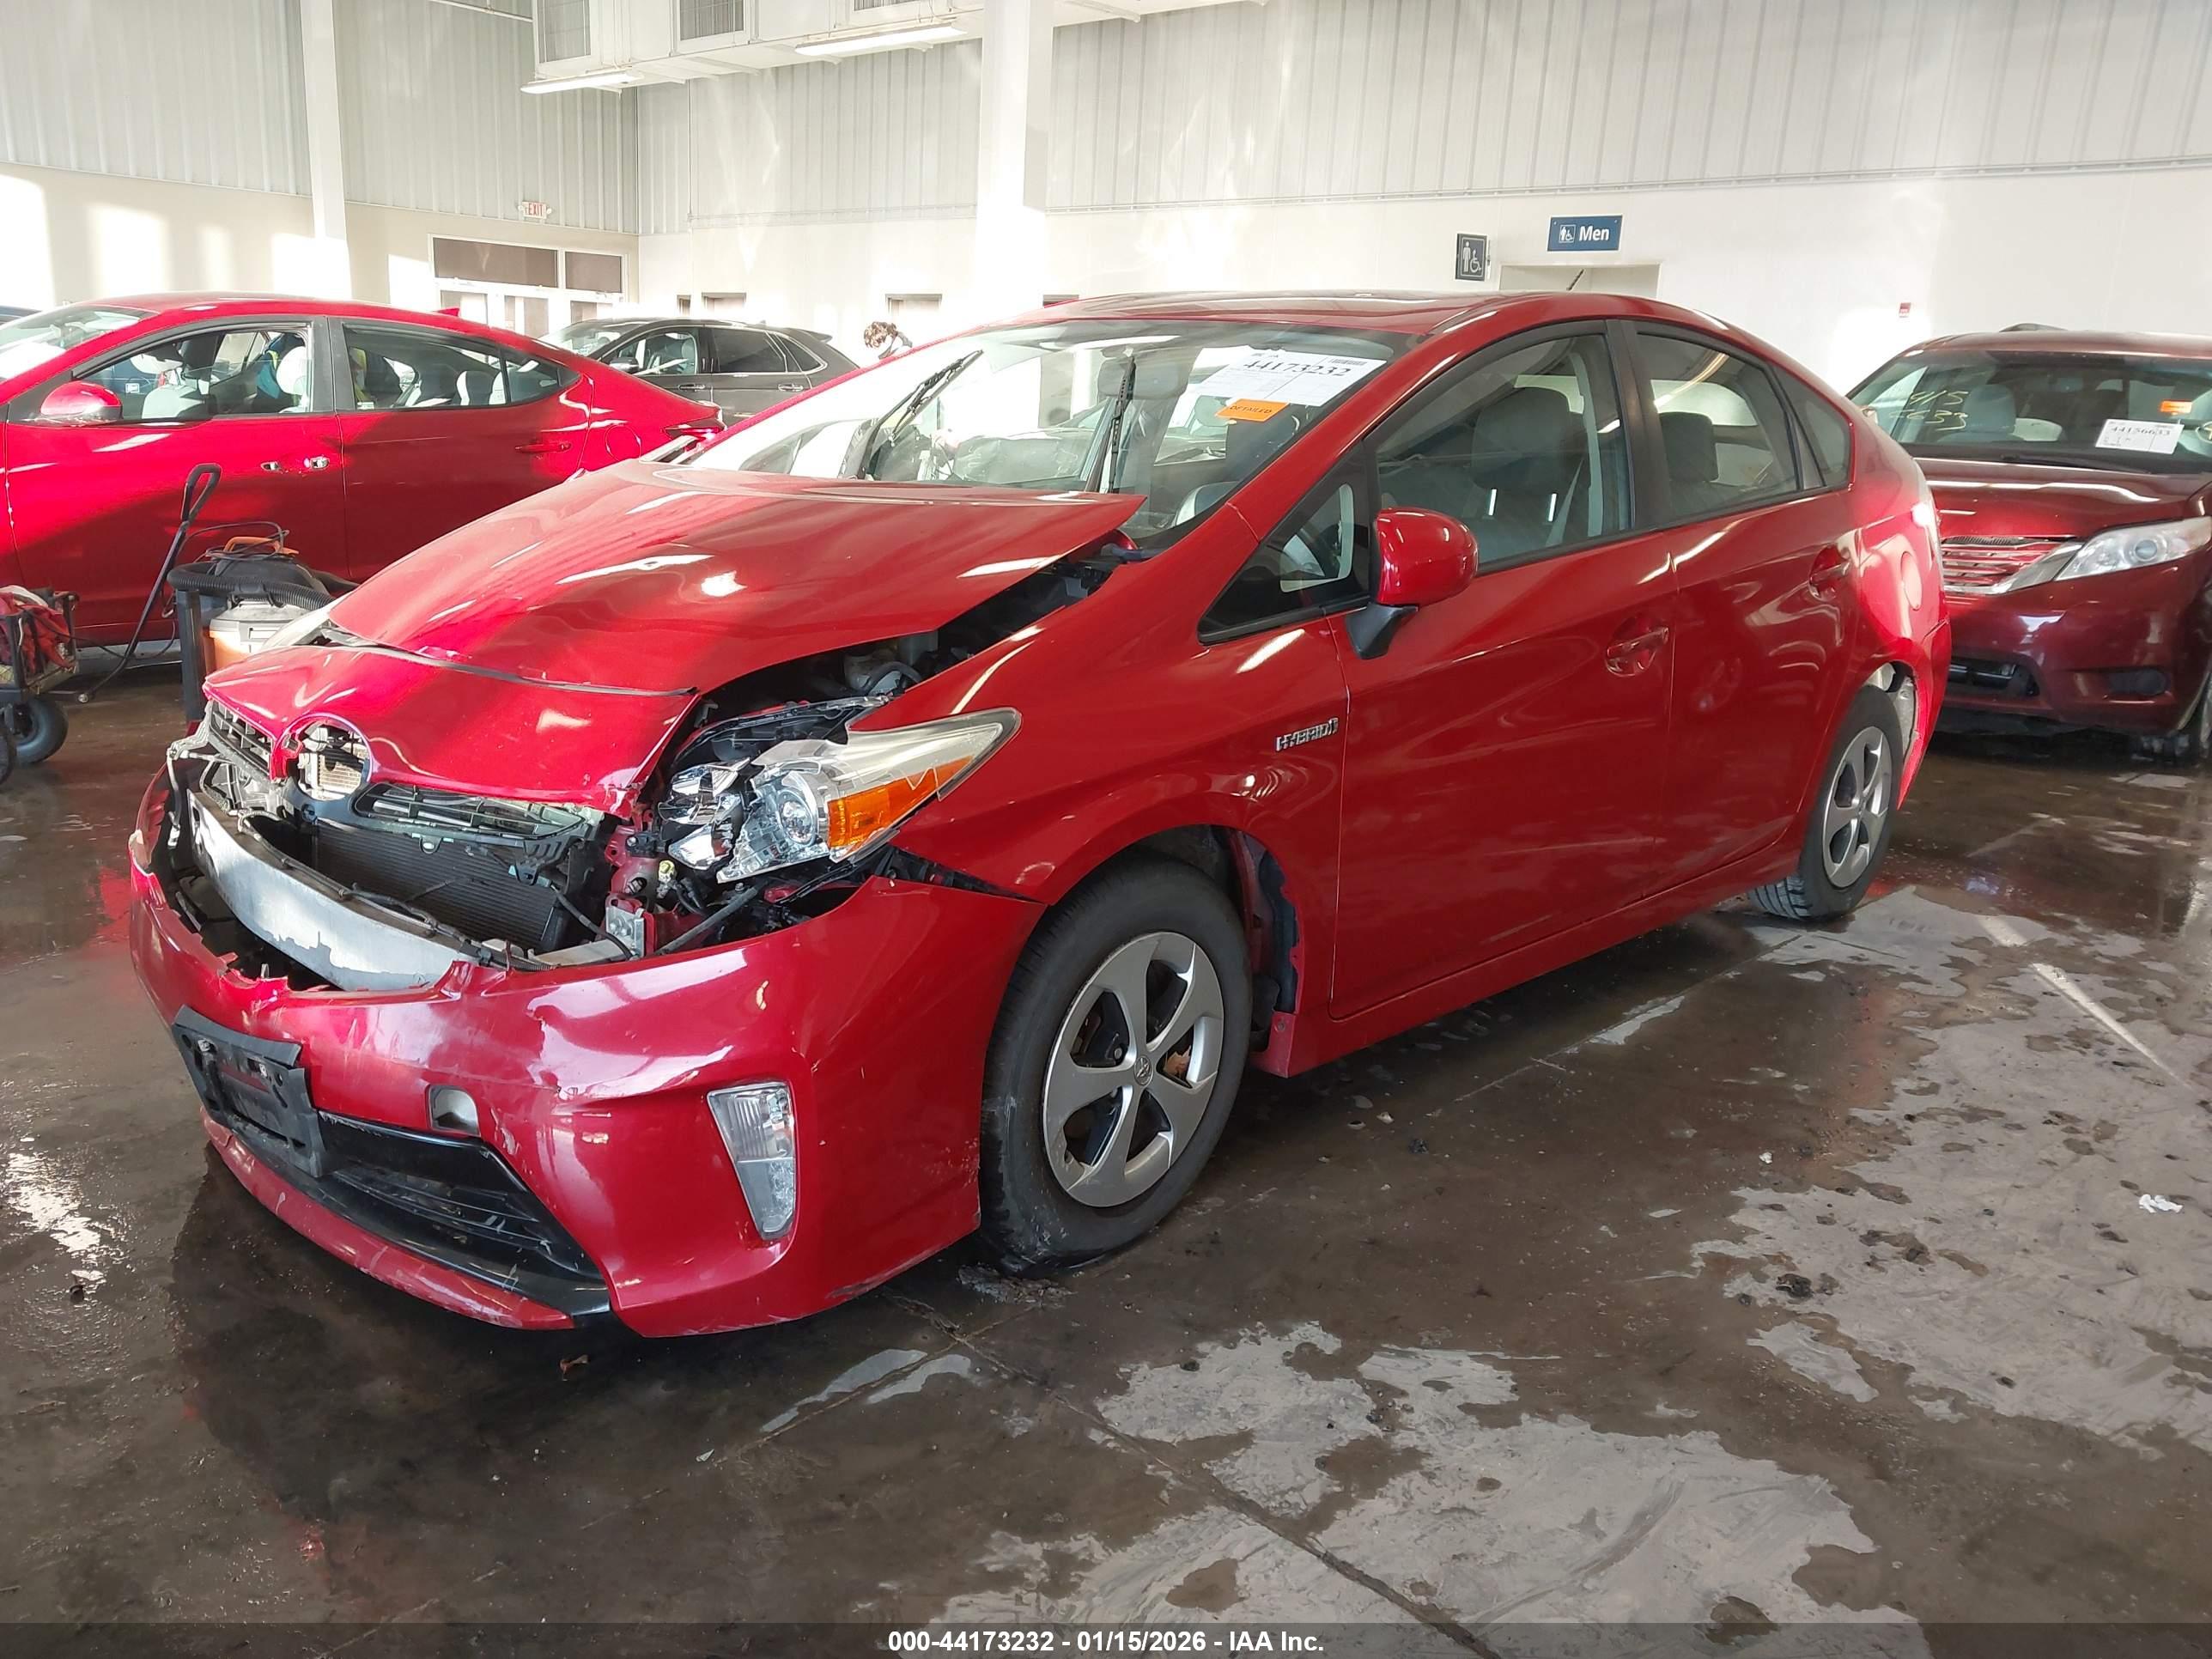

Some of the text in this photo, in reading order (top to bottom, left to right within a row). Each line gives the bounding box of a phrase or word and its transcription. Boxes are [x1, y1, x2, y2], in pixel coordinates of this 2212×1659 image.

[528, 203, 543, 216] EXIT
[1578, 225, 1610, 241] Men
[1243, 359, 1352, 377] 44173232
[1229, 404, 1273, 415] DETAILED
